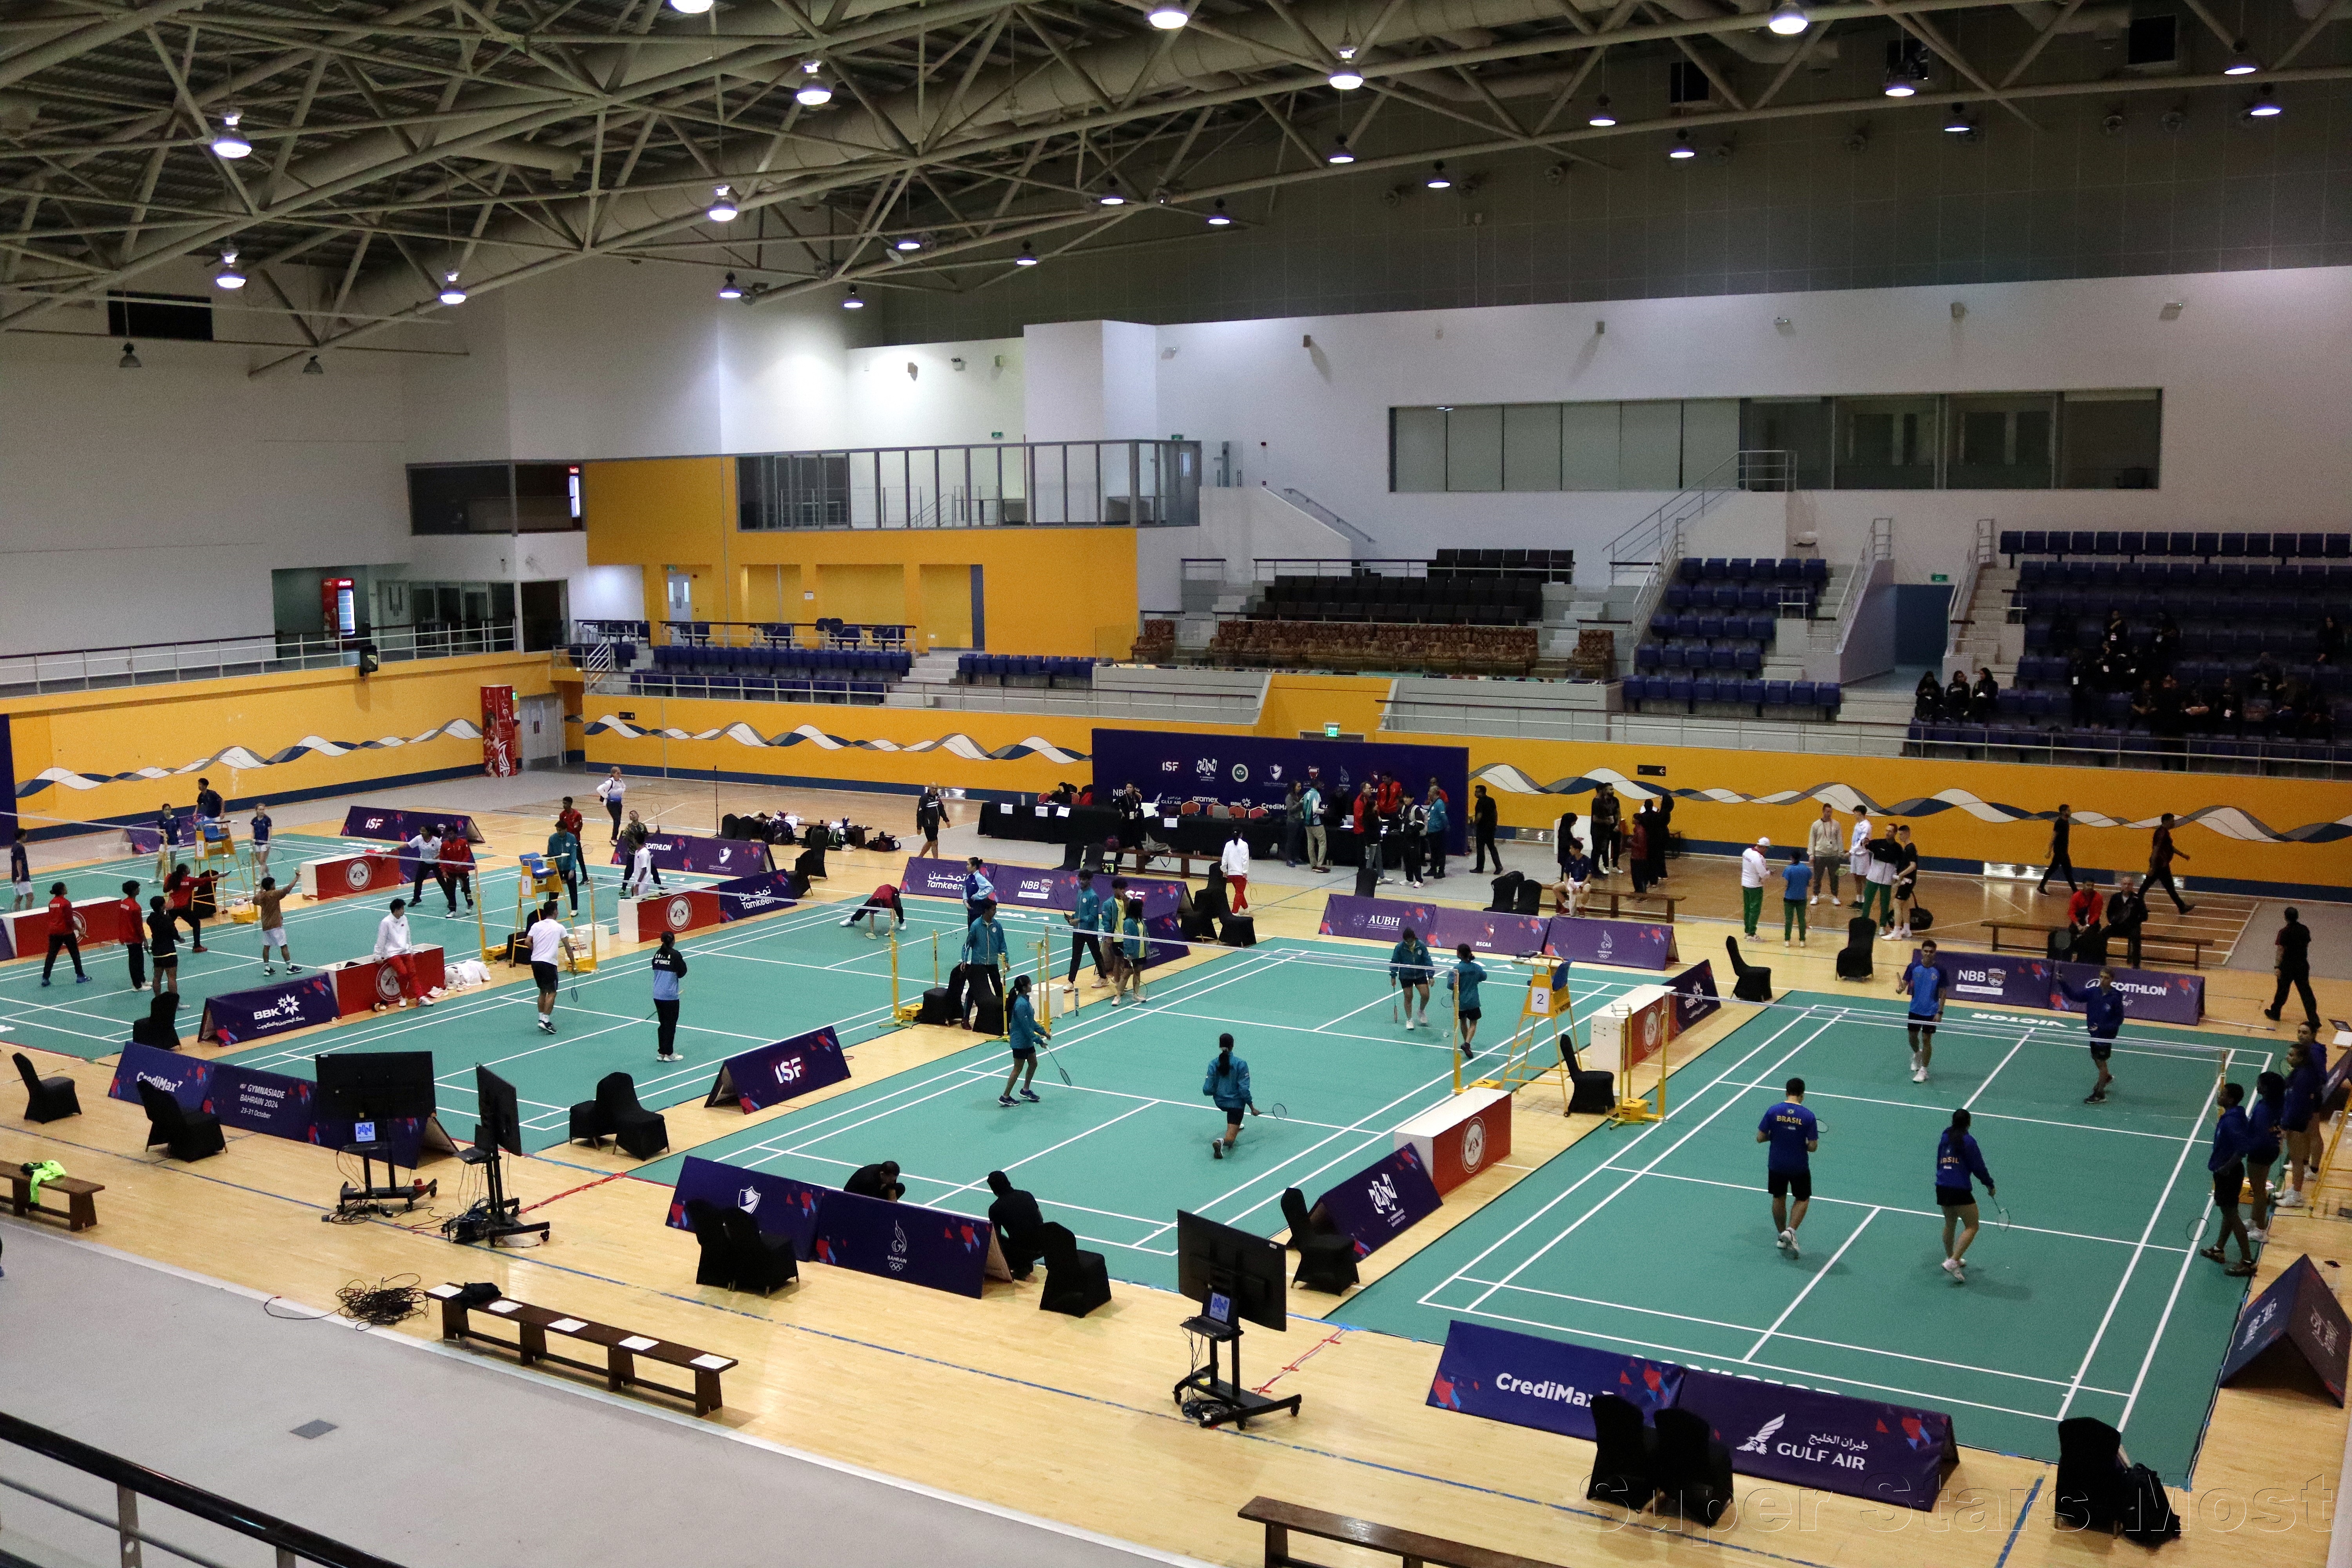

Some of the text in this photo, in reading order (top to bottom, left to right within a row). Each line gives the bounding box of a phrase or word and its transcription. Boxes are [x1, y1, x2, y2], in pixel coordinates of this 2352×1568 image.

[1162, 762, 1179, 771] ISF
[365, 818, 383, 829] ISF
[646, 843, 672, 851] CATHLON
[1020, 880, 1040, 890] NBB
[1125, 889, 1146, 900] SF
[741, 898, 775, 910] Tamkeen
[1368, 915, 1401, 926] AUBH
[1958, 969, 1986, 982] NBB
[2111, 982, 2167, 996] CATHLON
[1537, 994, 1544, 1004] 2
[253, 1007, 282, 1020] BBK
[1971, 1012, 2068, 1027] VICTOR
[774, 1056, 802, 1084] ISF
[247, 1084, 285, 1099] GYMNASIADE
[240, 1094, 278, 1109] BAHRAIN 2024
[241, 1107, 271, 1119] 23-31 October
[1777, 1115, 1802, 1125] BRASIL
[887, 1255, 907, 1264] BAHRAIN
[1809, 1433, 1869, 1450] طيران الخليج
[1777, 1443, 1866, 1470] GULF AIR
